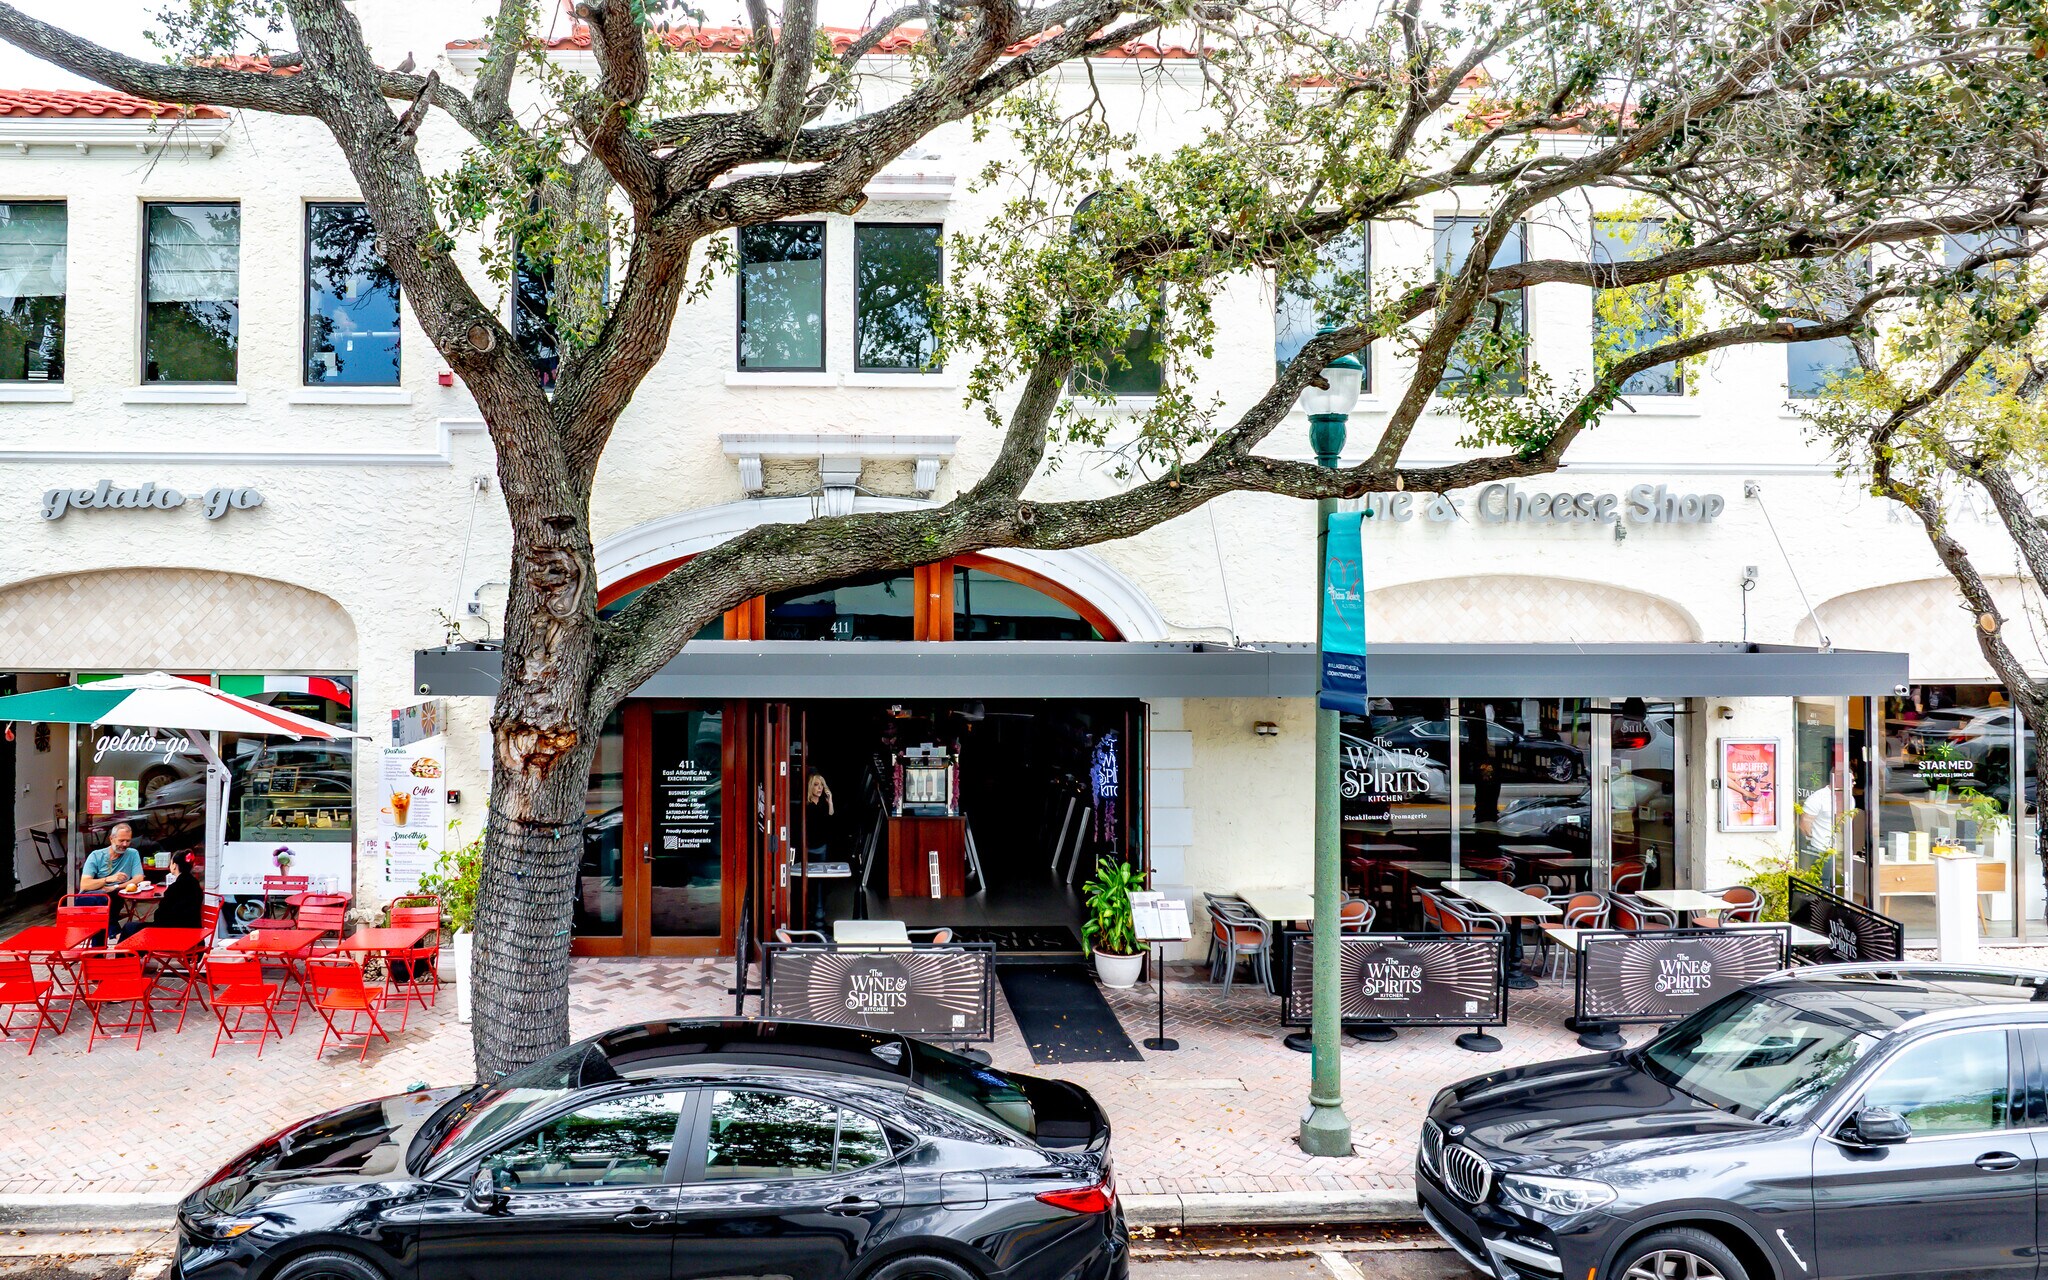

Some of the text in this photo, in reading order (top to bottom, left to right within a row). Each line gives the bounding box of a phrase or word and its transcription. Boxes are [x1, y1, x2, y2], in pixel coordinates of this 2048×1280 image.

[41, 479, 264, 521] gelato-go
[1477, 482, 1617, 524] Cheese
[1626, 483, 1725, 524] Shop
[830, 622, 849, 633] 411
[94, 728, 190, 764] gelato-go
[1373, 736, 1393, 747] The
[679, 760, 695, 769] 411
[1919, 761, 1973, 770] STAR MED
[1340, 770, 1430, 798] SPIRITS
[413, 786, 435, 796] Coffee
[1390, 812, 1427, 820] Fromagerie
[391, 832, 427, 841] Smoothies
[1385, 957, 1399, 965] The
[869, 969, 882, 977] The
[1362, 978, 1422, 995] SPIRITS
[1655, 974, 1711, 992] SPIRITS
[845, 990, 907, 1009] SPIRITS
